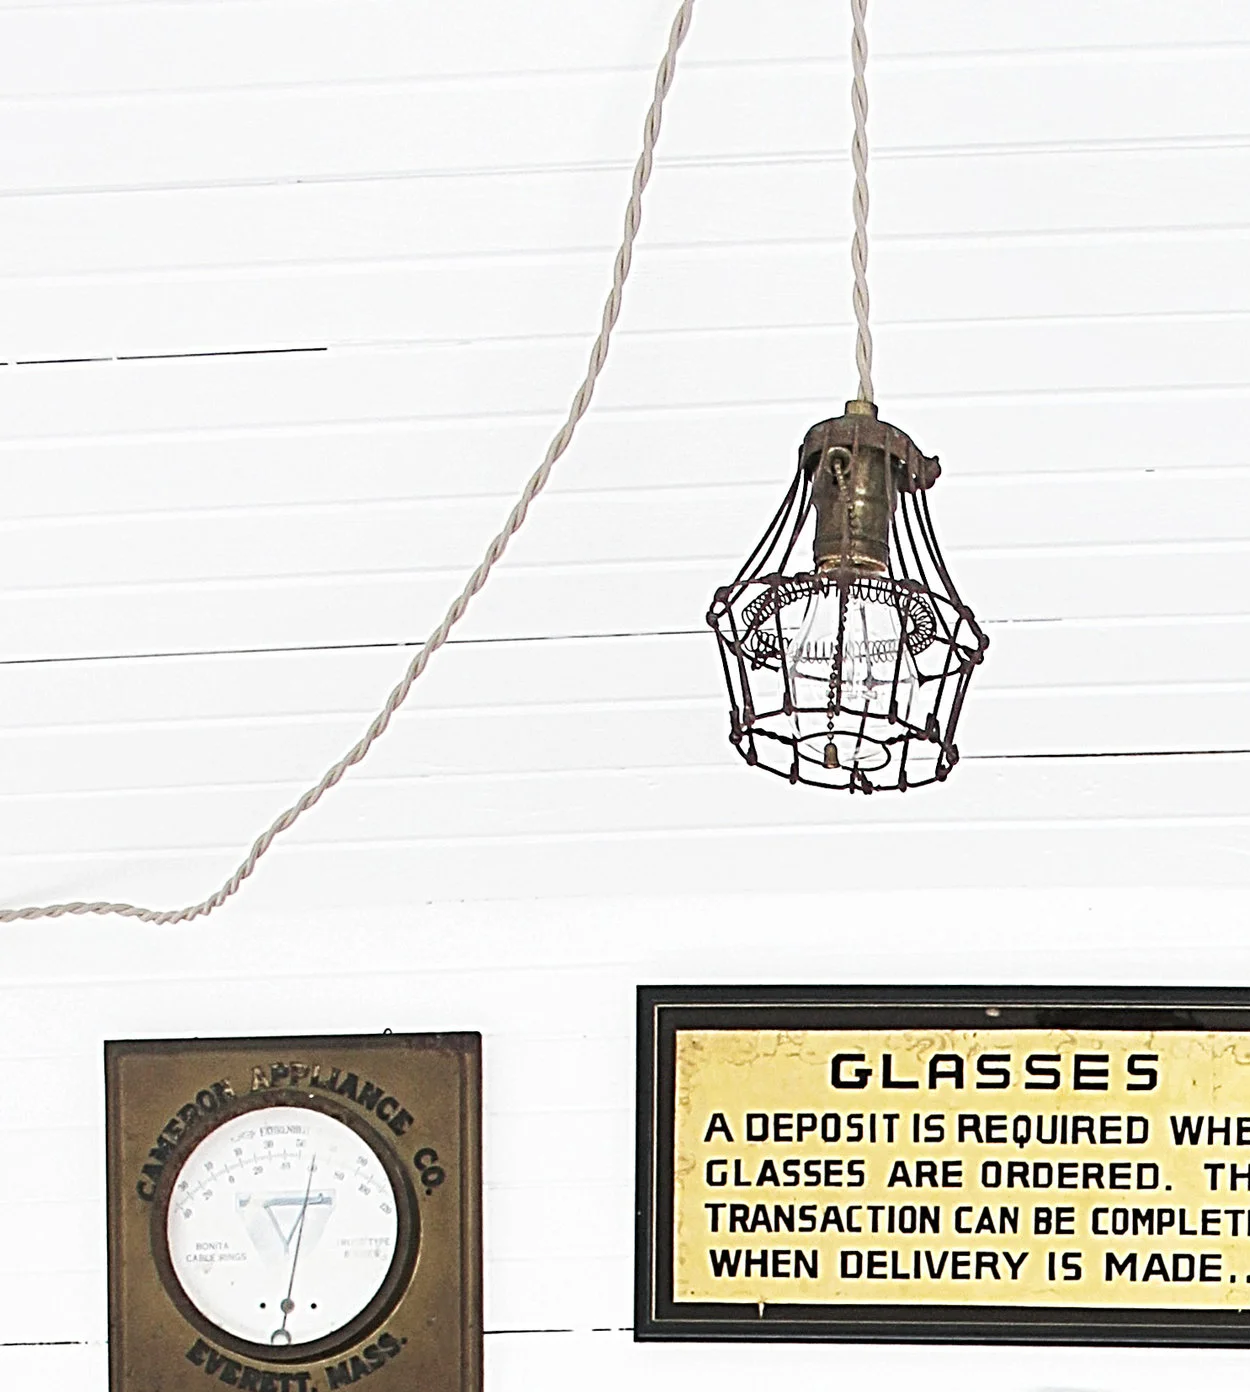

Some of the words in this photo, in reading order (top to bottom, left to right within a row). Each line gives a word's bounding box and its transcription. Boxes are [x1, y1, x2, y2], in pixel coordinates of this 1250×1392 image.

[831, 1053, 1160, 1091] GLASSES
[136, 1078, 236, 1200] CAMERON
[250, 1062, 413, 1137] APPLIANCE
[413, 1148, 445, 1196] CO.
[704, 1113, 733, 1142] A
[746, 1113, 899, 1143] DEPOSIT
[913, 1114, 945, 1143] IS
[958, 1115, 1149, 1145] REQUIRED
[706, 1160, 865, 1189] GLASSES
[887, 1161, 963, 1189] ARE
[981, 1162, 1173, 1191] ORDERED.
[704, 1203, 941, 1235] TRANSACTION
[954, 1205, 1018, 1235] CAN
[1034, 1206, 1075, 1236] BE
[186, 1253, 215, 1262] CABLE
[709, 1250, 818, 1279] WHEN
[840, 1250, 1029, 1282] DELIVERY
[1048, 1253, 1082, 1282] IS
[325, 1332, 407, 1390] MASS.
